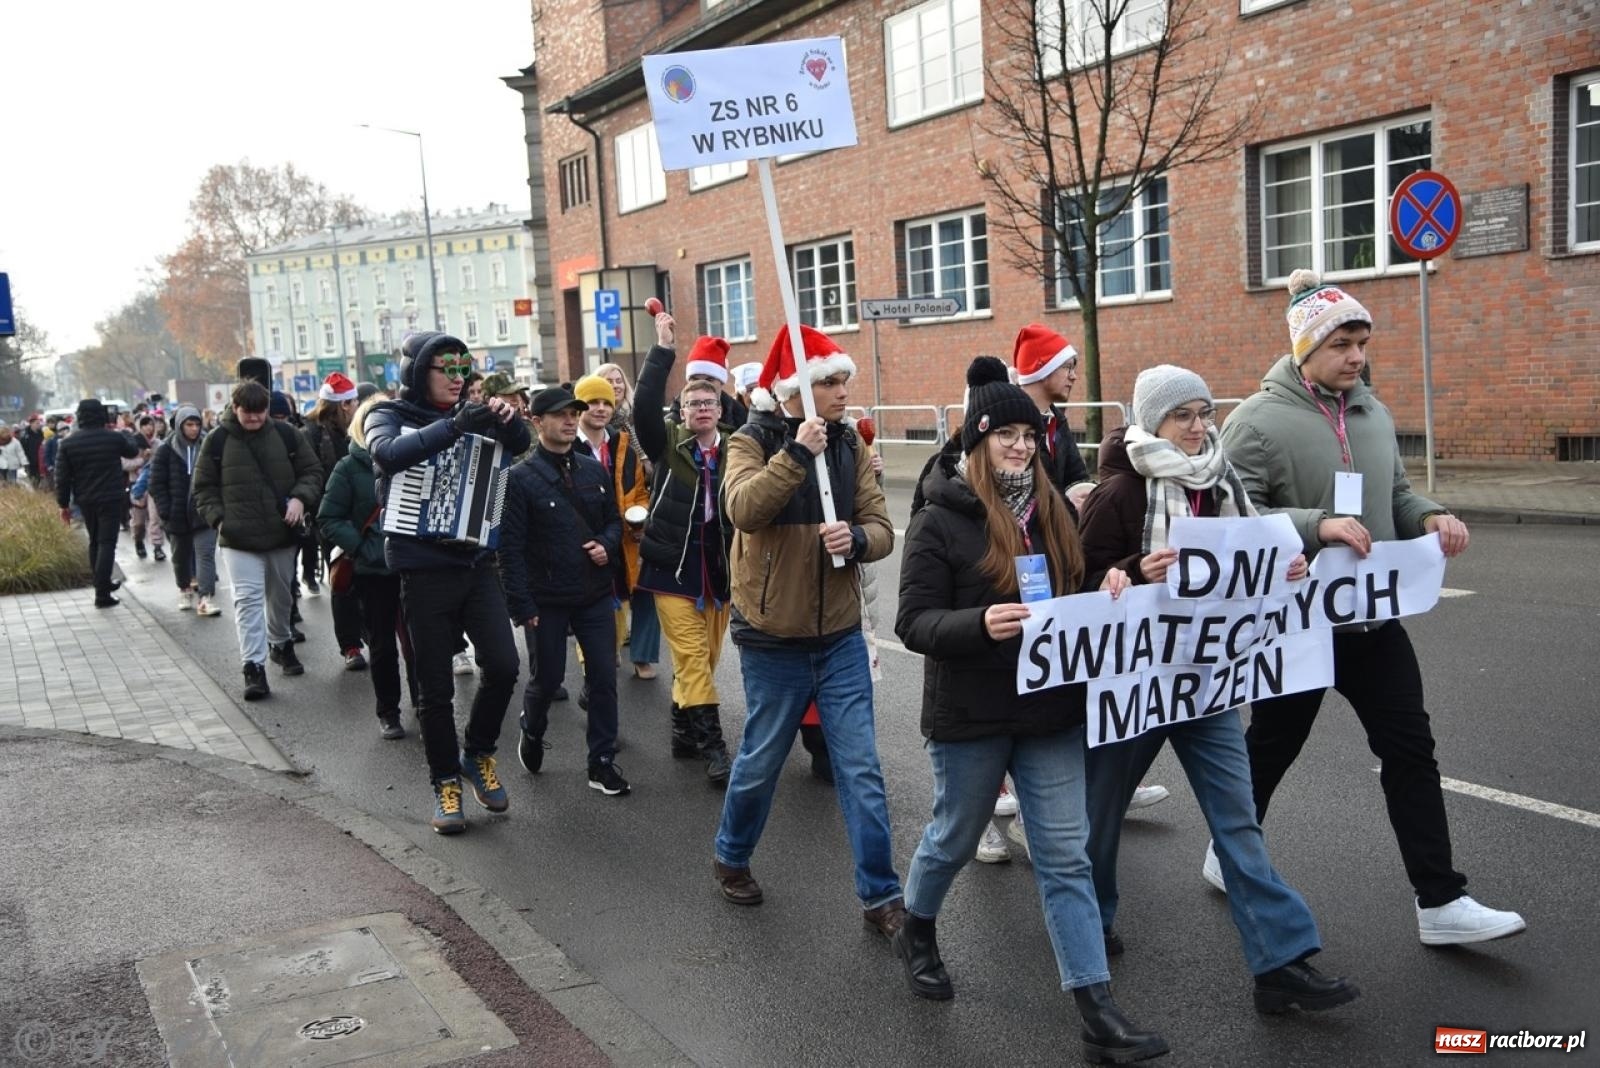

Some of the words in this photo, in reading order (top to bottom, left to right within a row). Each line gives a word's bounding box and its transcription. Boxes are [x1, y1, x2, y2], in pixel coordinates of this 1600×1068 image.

[709, 100, 740, 122] ZS
[746, 95, 780, 118] NR
[786, 93, 799, 112] 6
[692, 132, 715, 154] W
[722, 118, 824, 151] RYBNIKU
[600, 293, 615, 314] P
[883, 304, 911, 314] Hotel
[1177, 546, 1279, 599] DNI
[1098, 638, 1283, 744] MARZEŃ
